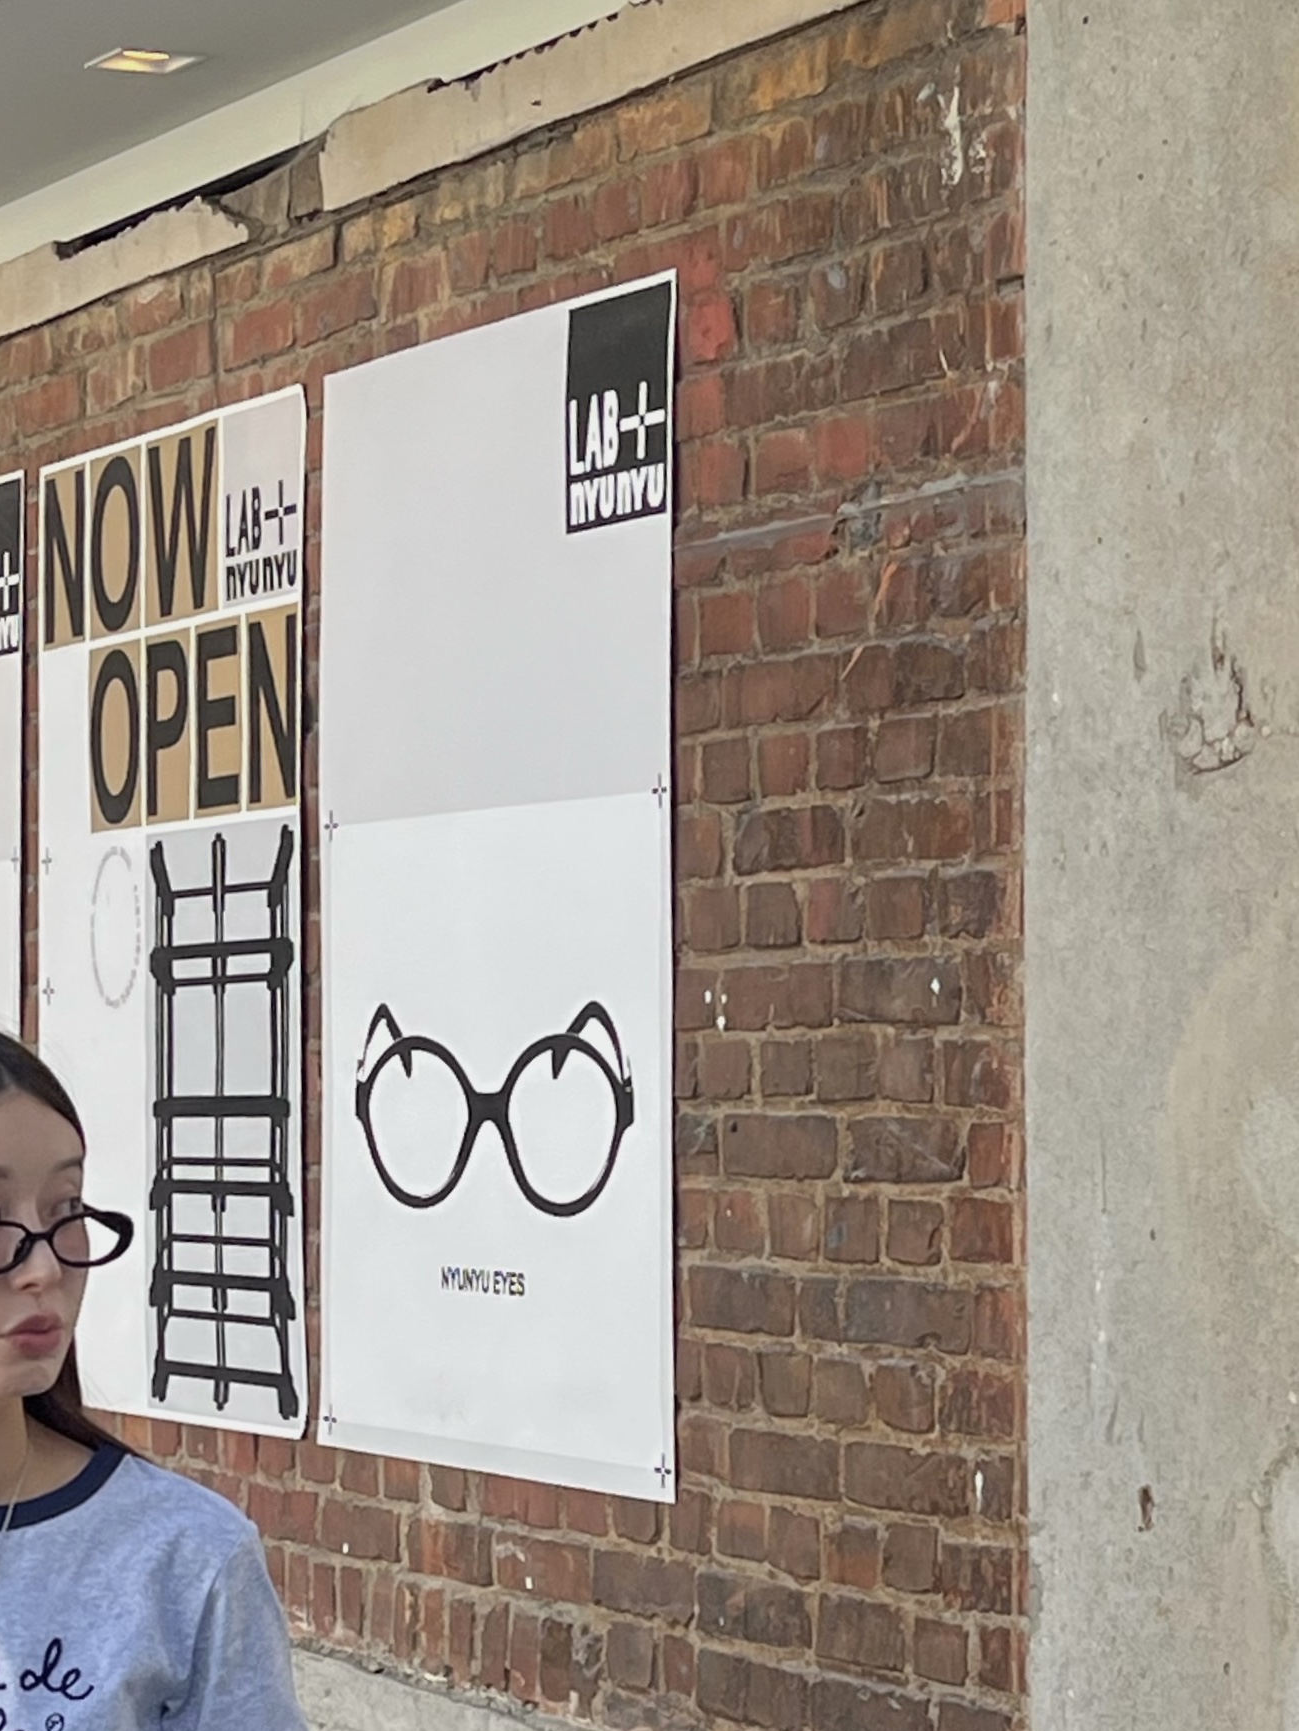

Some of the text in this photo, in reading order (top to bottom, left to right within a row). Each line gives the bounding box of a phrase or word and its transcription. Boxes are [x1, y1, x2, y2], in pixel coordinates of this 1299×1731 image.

[44, 426, 217, 644] NOW
[90, 613, 297, 824] OPEN
[440, 1265, 526, 1297] NYUNYU EYES
[19, 1636, 95, 1701] de
